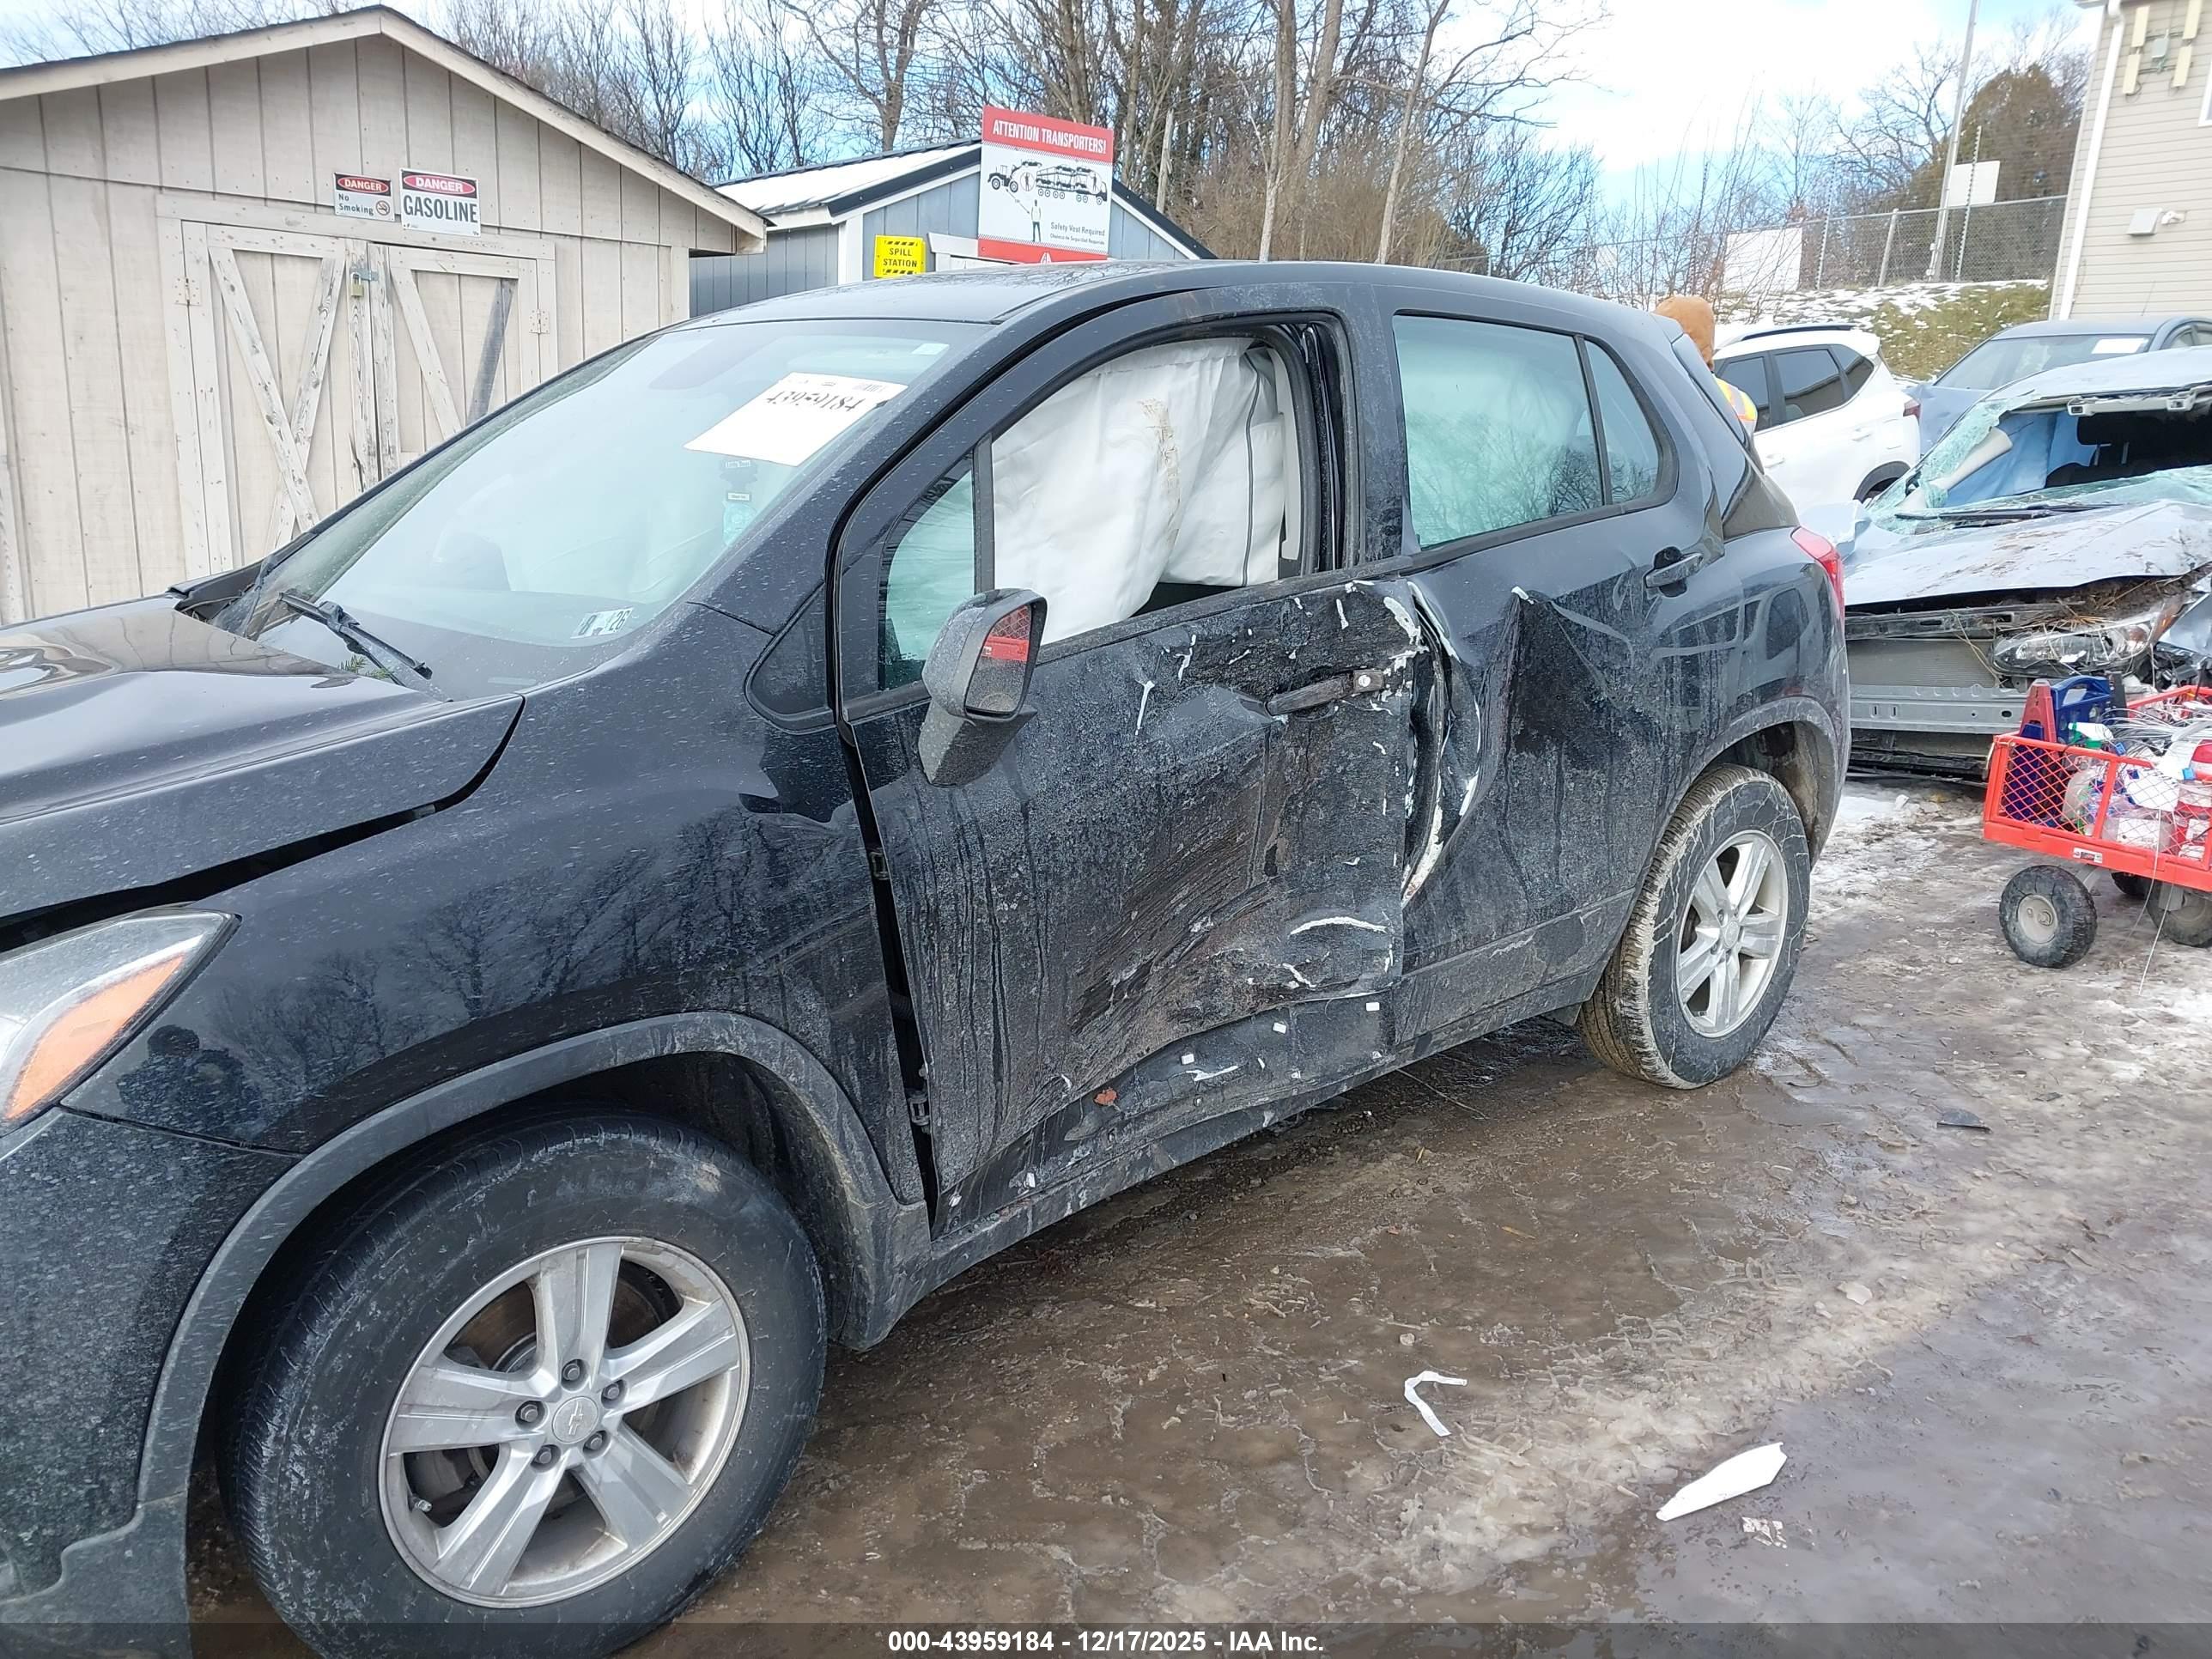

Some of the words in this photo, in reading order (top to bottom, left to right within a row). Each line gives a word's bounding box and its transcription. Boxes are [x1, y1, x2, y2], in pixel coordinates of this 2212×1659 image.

[993, 119, 1040, 142] ATTENTION
[1042, 128, 1106, 154] TRANSPORTERS!
[344, 179, 382, 191] DANGER
[416, 177, 464, 192] DANGER
[338, 193, 349, 202] No
[339, 203, 374, 216] Smoking
[403, 195, 478, 223] GASOLINE
[1050, 222, 1067, 232] Safety
[889, 248, 912, 257] SPILL
[883, 258, 917, 267] STATION
